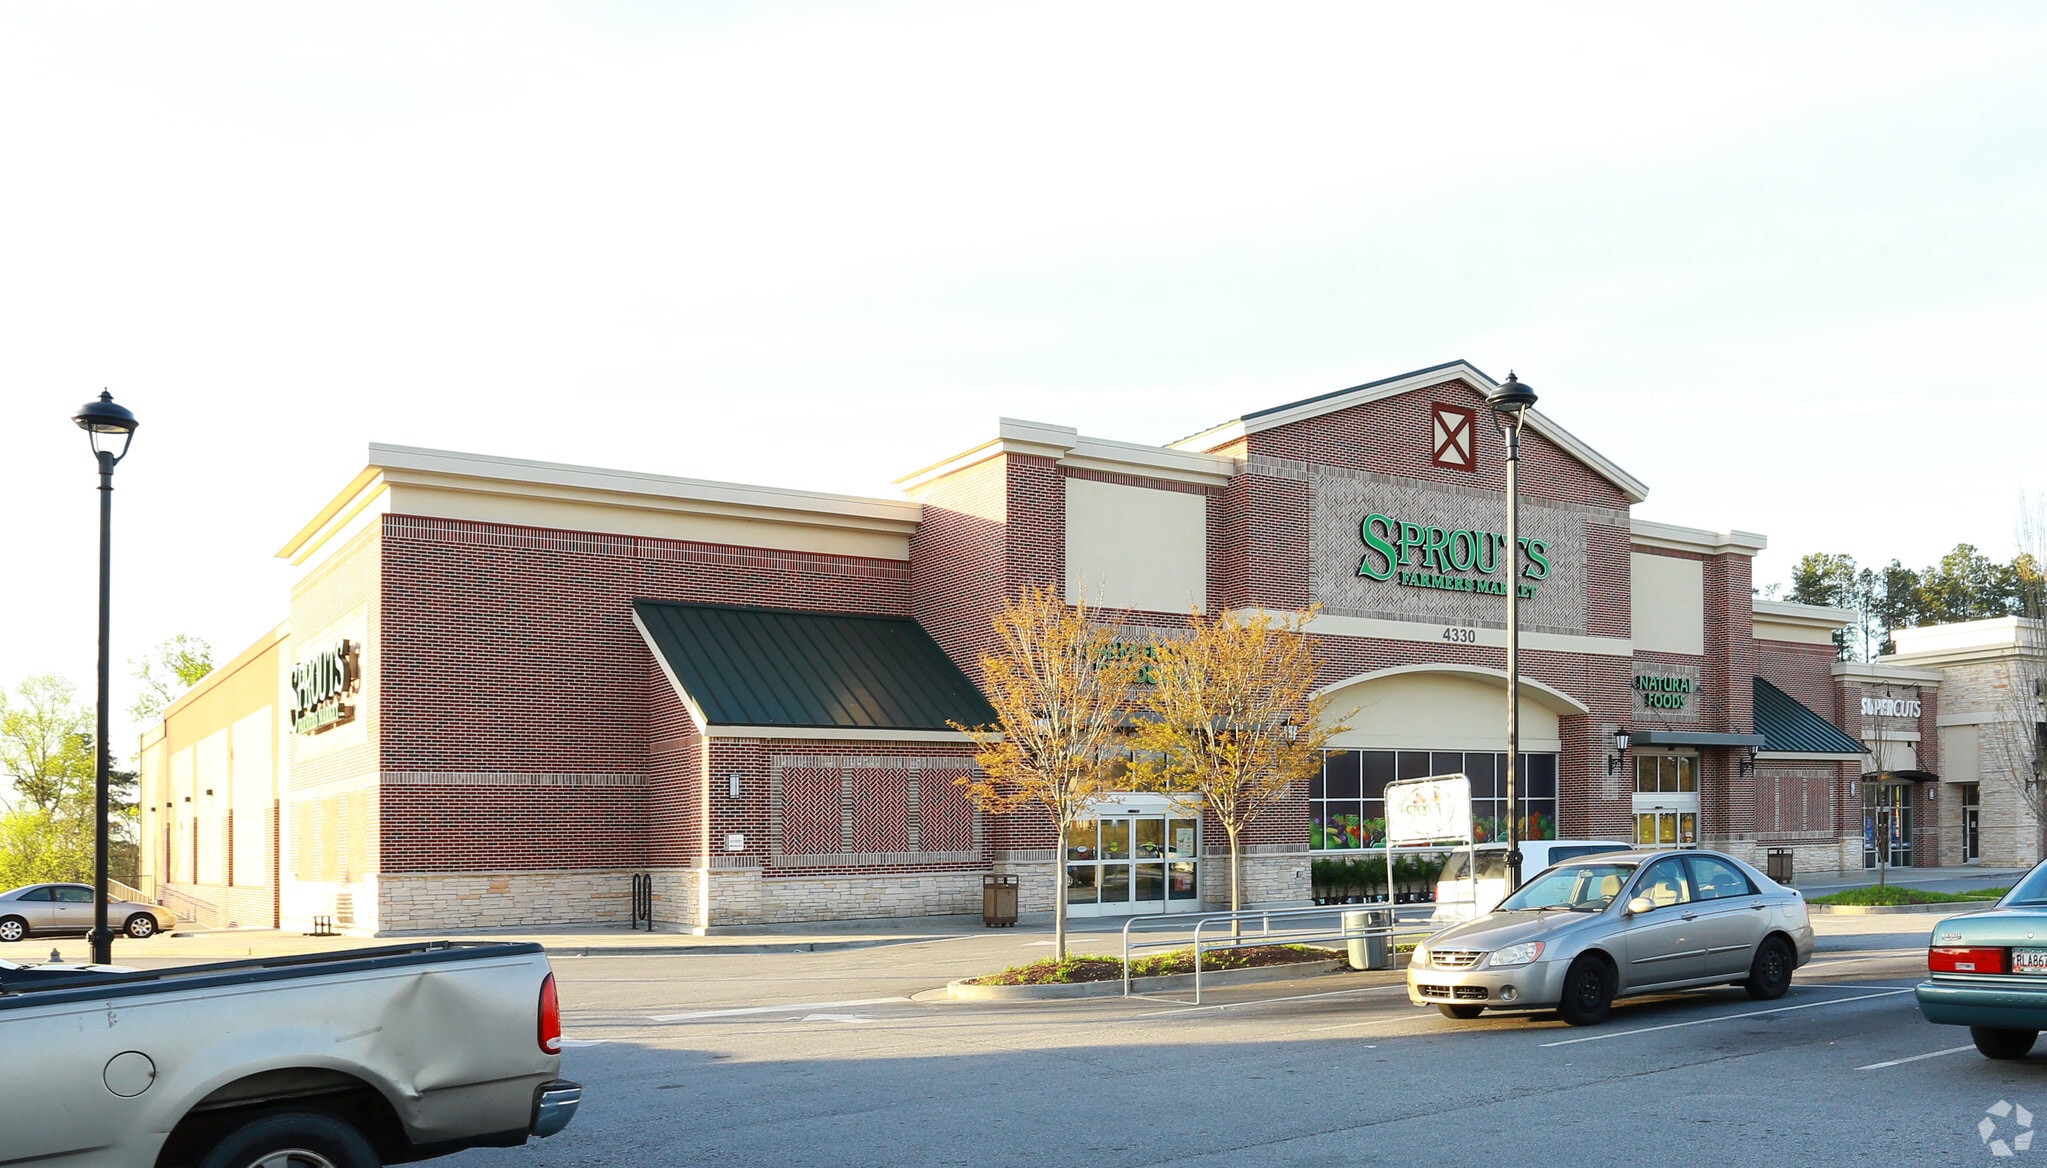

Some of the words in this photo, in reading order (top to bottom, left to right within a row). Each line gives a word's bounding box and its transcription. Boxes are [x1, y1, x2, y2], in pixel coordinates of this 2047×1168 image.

[1401, 570, 1473, 592] FARMERS
[1476, 578, 1537, 599] MARET
[1442, 627, 1476, 643] 4330
[290, 640, 344, 733] SPROUTS
[1639, 675, 1694, 693] NATURAL
[1648, 693, 1686, 710] FOODS
[1860, 697, 1921, 718] SUPERCUTS
